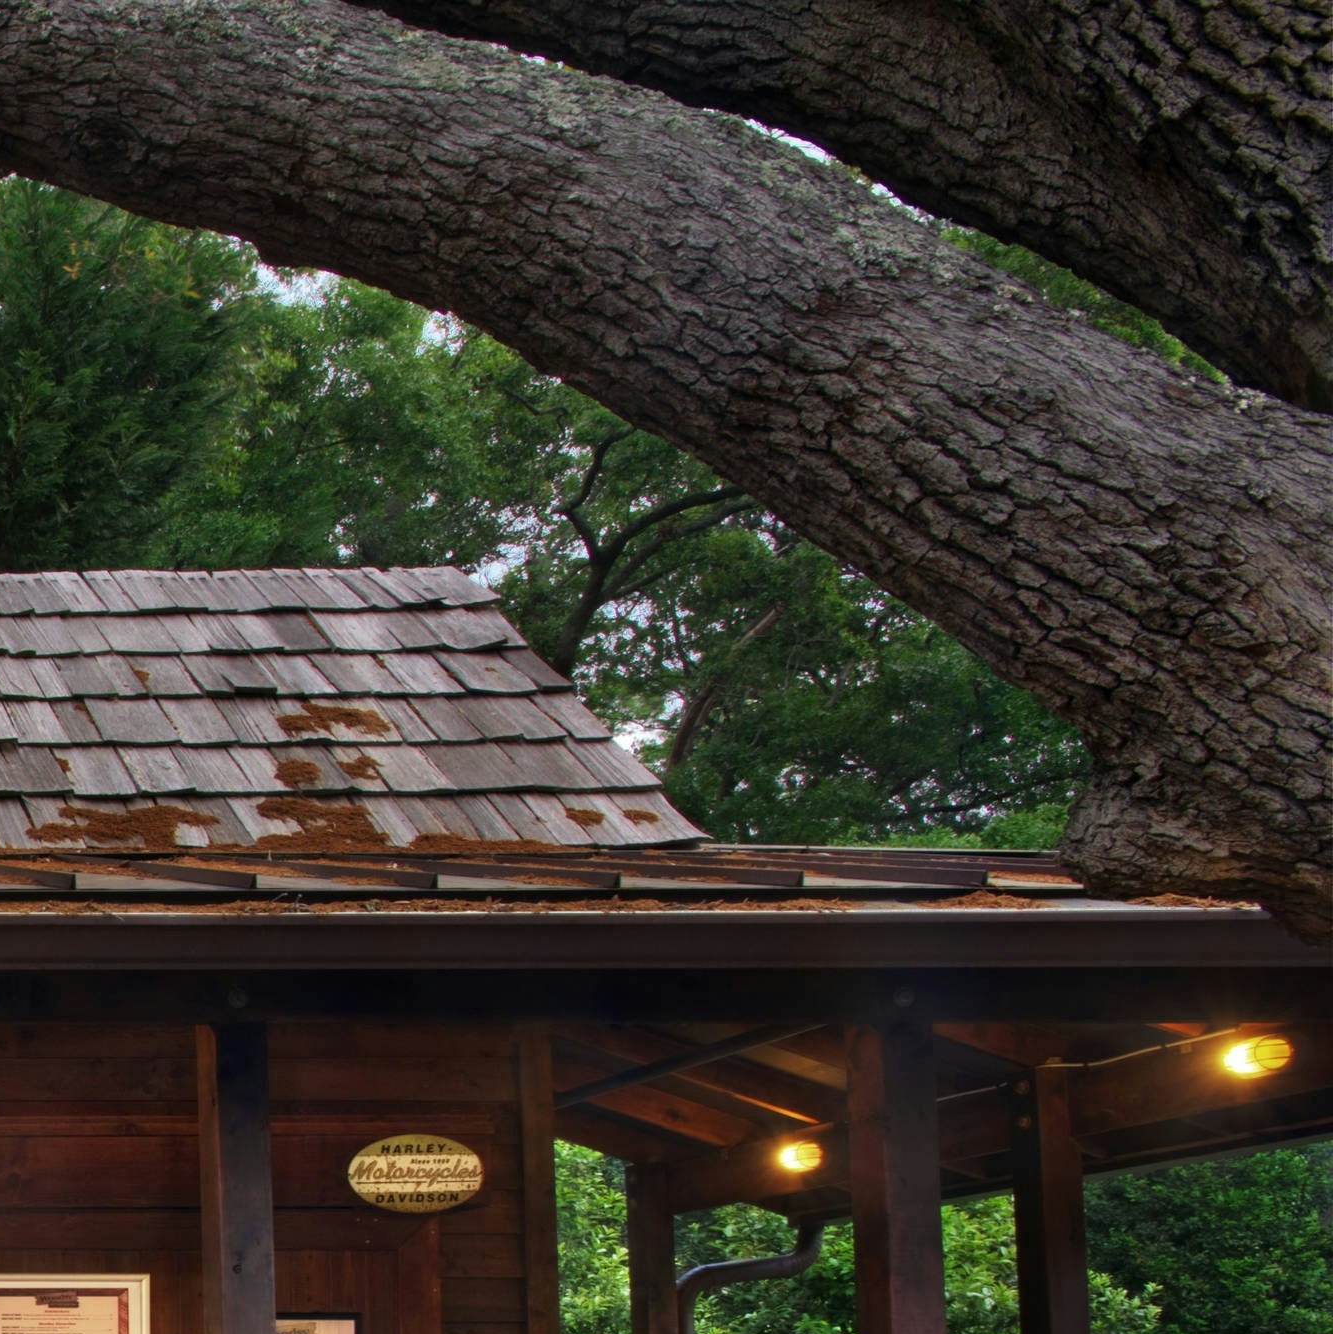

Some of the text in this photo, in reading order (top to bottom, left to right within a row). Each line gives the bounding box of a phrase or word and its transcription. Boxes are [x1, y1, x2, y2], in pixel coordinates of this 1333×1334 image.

[380, 1143, 452, 1154] HARLEY-
[350, 1159, 484, 1188] Motorcycles
[375, 1193, 460, 1204] DAVIDSON
